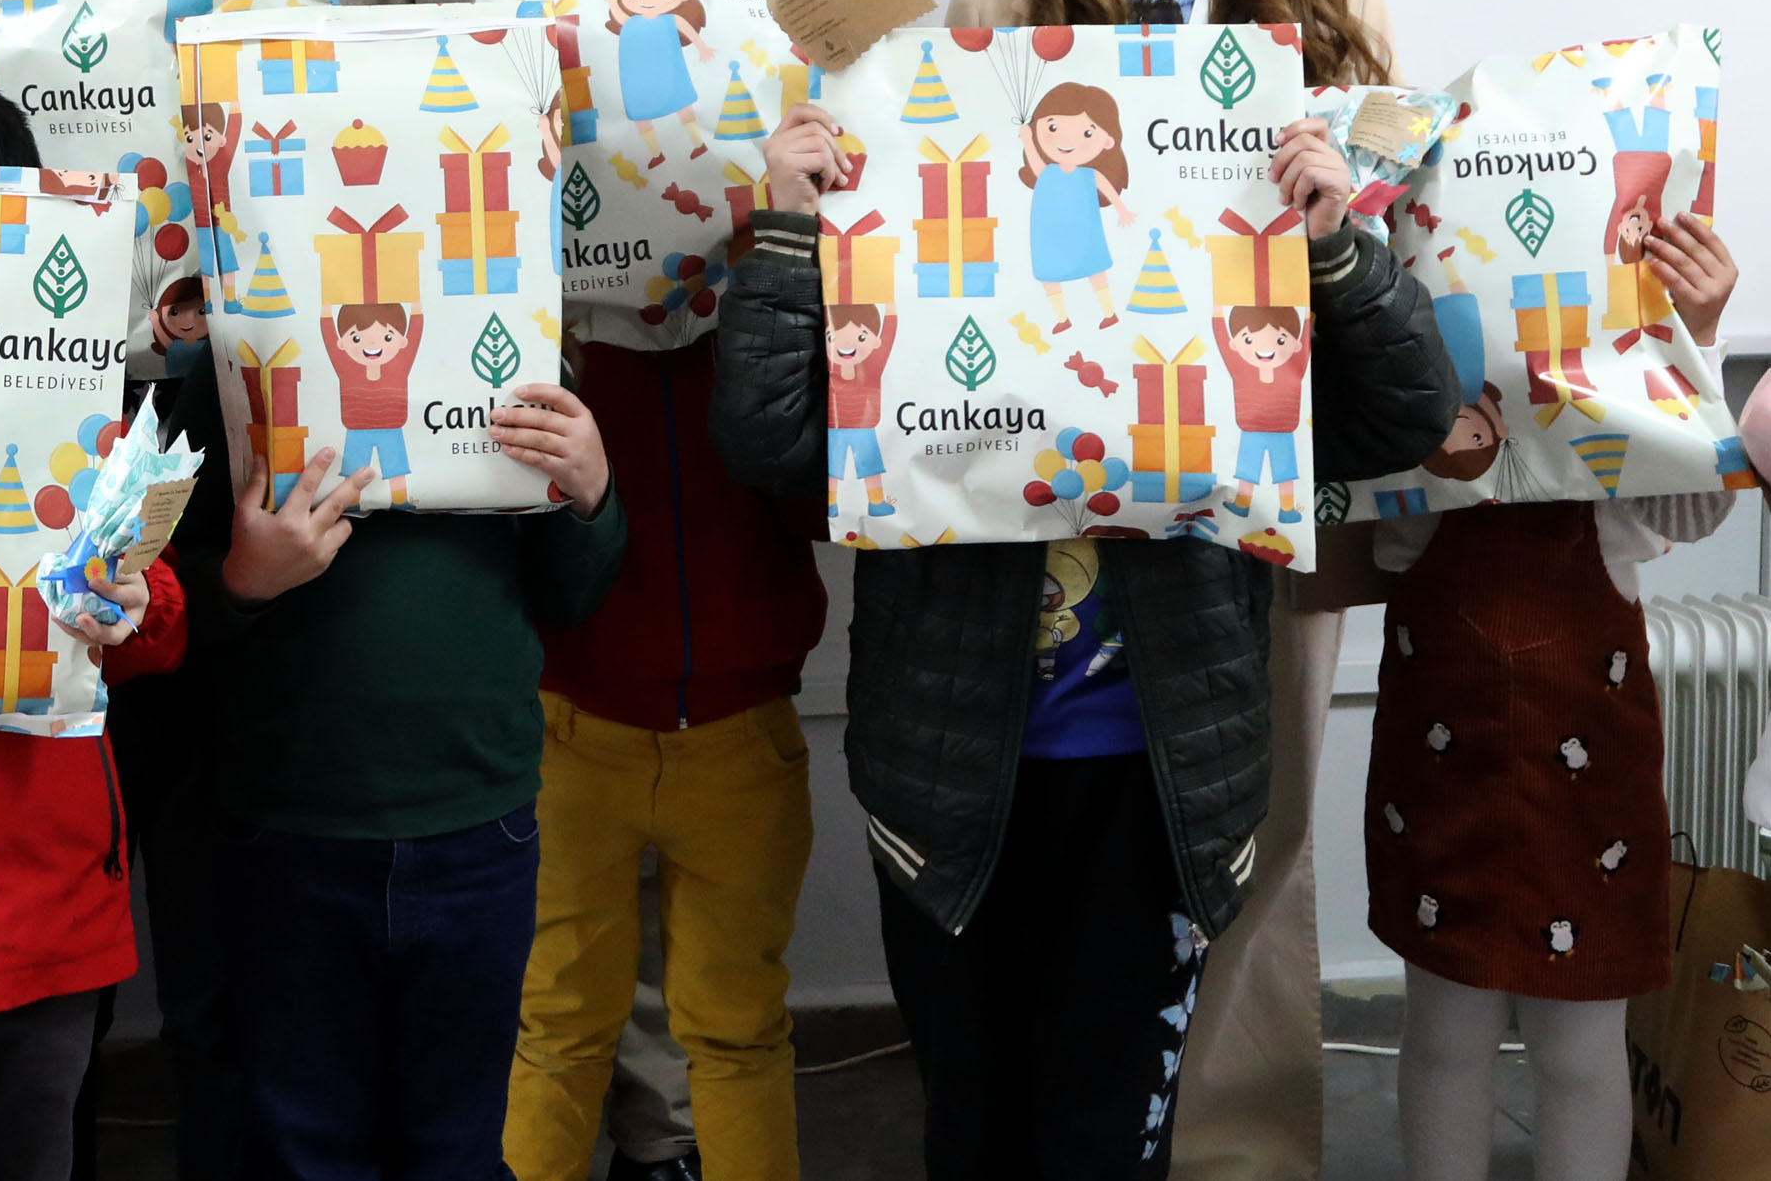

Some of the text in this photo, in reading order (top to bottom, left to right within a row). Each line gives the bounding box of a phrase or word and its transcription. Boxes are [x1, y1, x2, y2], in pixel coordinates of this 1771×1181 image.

[22, 81, 156, 116] Çankaya
[49, 118, 133, 135] BELEDİYESİ
[1148, 119, 1284, 158] Çankay
[1179, 164, 1270, 180] BELEDİYE
[1455, 145, 1597, 180] Çankaya
[562, 238, 652, 269] nkaya
[562, 272, 630, 292] LEDİYESİ
[4, 374, 104, 391] BELEDİYESİ
[897, 400, 1047, 436] Çankaya
[452, 441, 501, 454] BELED
[925, 437, 1019, 456] BELEDİYESİ
